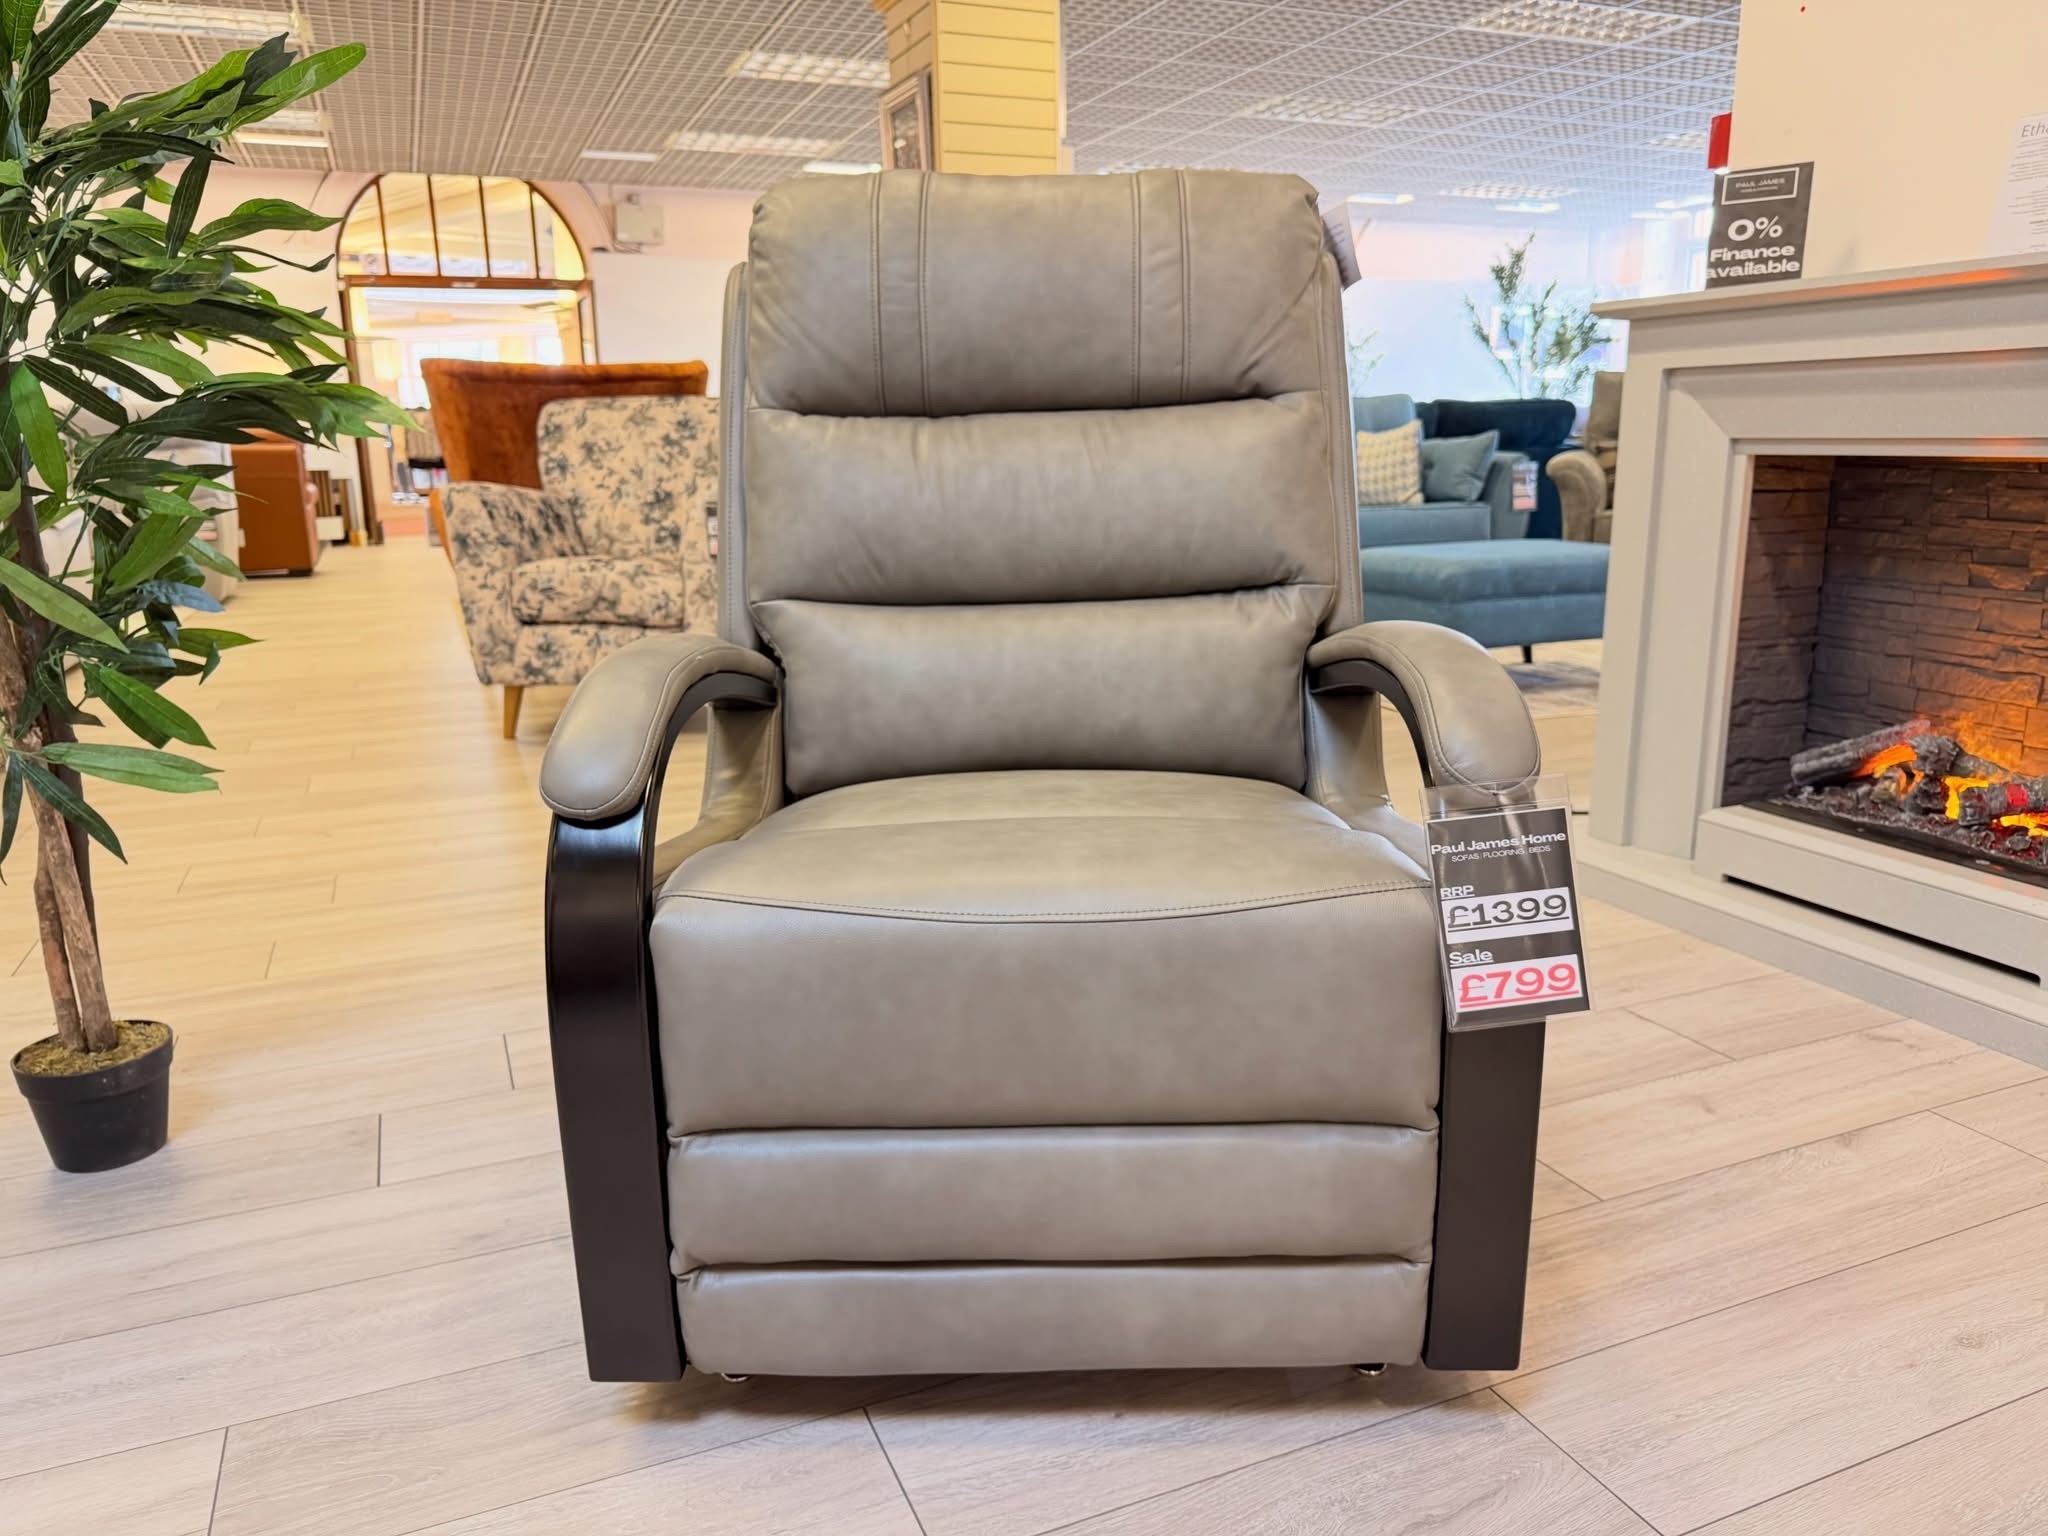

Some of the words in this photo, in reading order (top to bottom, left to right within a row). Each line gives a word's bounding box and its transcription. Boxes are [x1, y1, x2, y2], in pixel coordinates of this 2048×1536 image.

[1727, 215, 1783, 242] 0%
[1709, 244, 1795, 263] Finance
[1706, 259, 1800, 279] available
[1431, 841, 1465, 855] Paul
[1467, 837, 1519, 851] James
[1521, 832, 1566, 845] Home
[1451, 852, 1480, 862] SOFAS
[1483, 847, 1525, 858] FLOORING
[1529, 845, 1551, 854] BEDS
[1440, 885, 1475, 900] RRP
[1447, 894, 1568, 930] £1399
[1449, 949, 1494, 966] Sale
[1459, 963, 1578, 1006] £799
